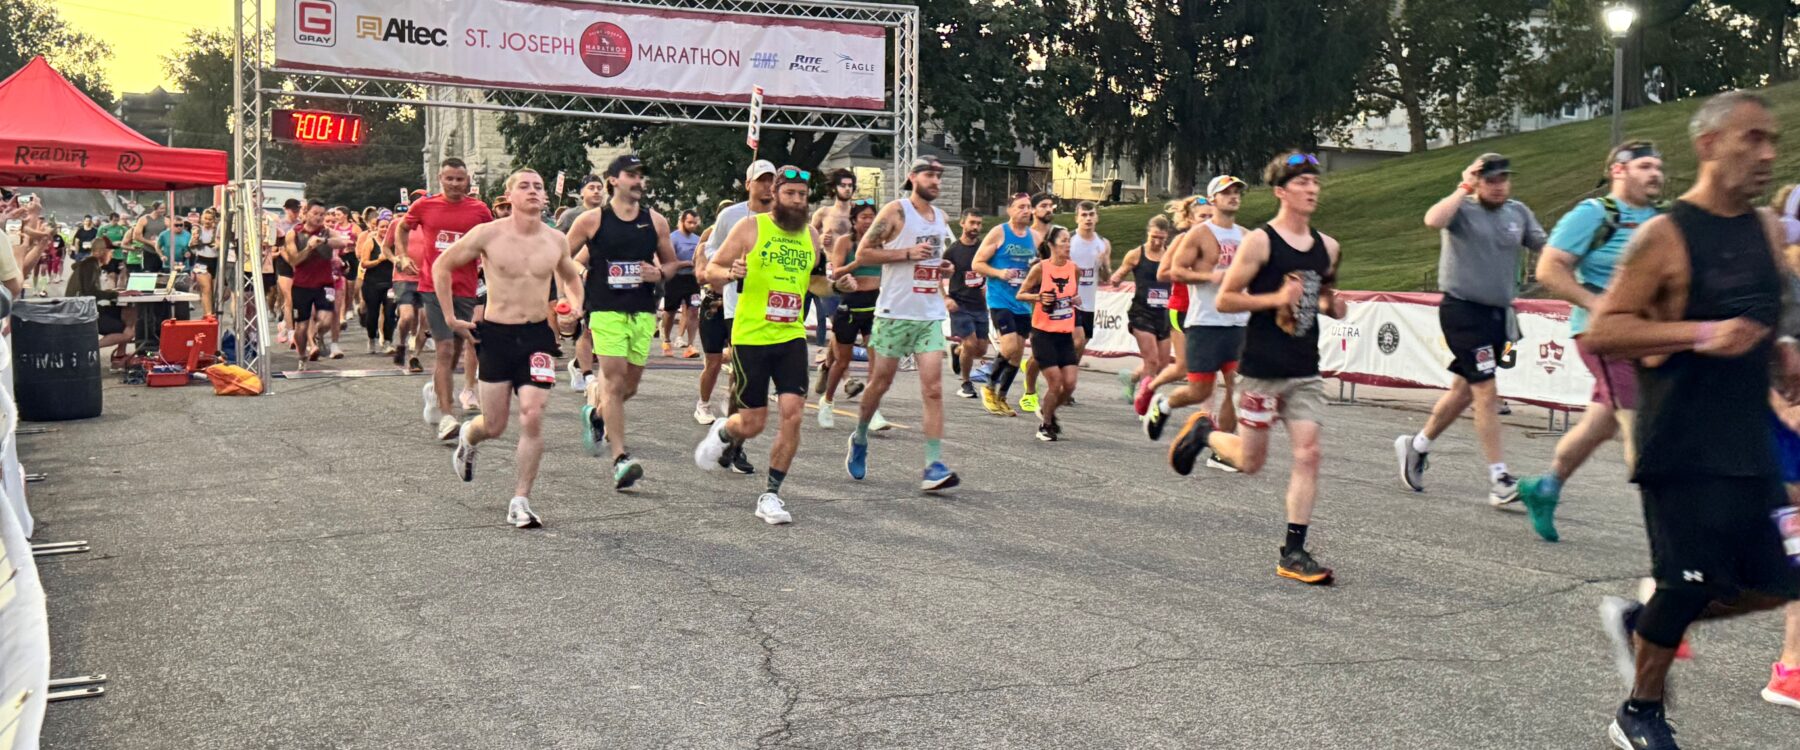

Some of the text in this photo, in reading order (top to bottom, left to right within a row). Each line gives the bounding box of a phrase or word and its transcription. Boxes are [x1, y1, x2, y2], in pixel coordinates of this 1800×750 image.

[298, 35, 331, 44] GRAY
[382, 18, 448, 47] Altec
[464, 28, 740, 67] ST. JOSEPH MARATHON
[585, 44, 627, 53] MARATHON
[752, 52, 778, 69] BMS
[845, 62, 875, 72] EAGLE
[292, 112, 360, 142] 7:00:11
[770, 251, 808, 271] Pacing
[1095, 309, 1122, 330] Altec
[1331, 326, 1360, 337] ULTRA
